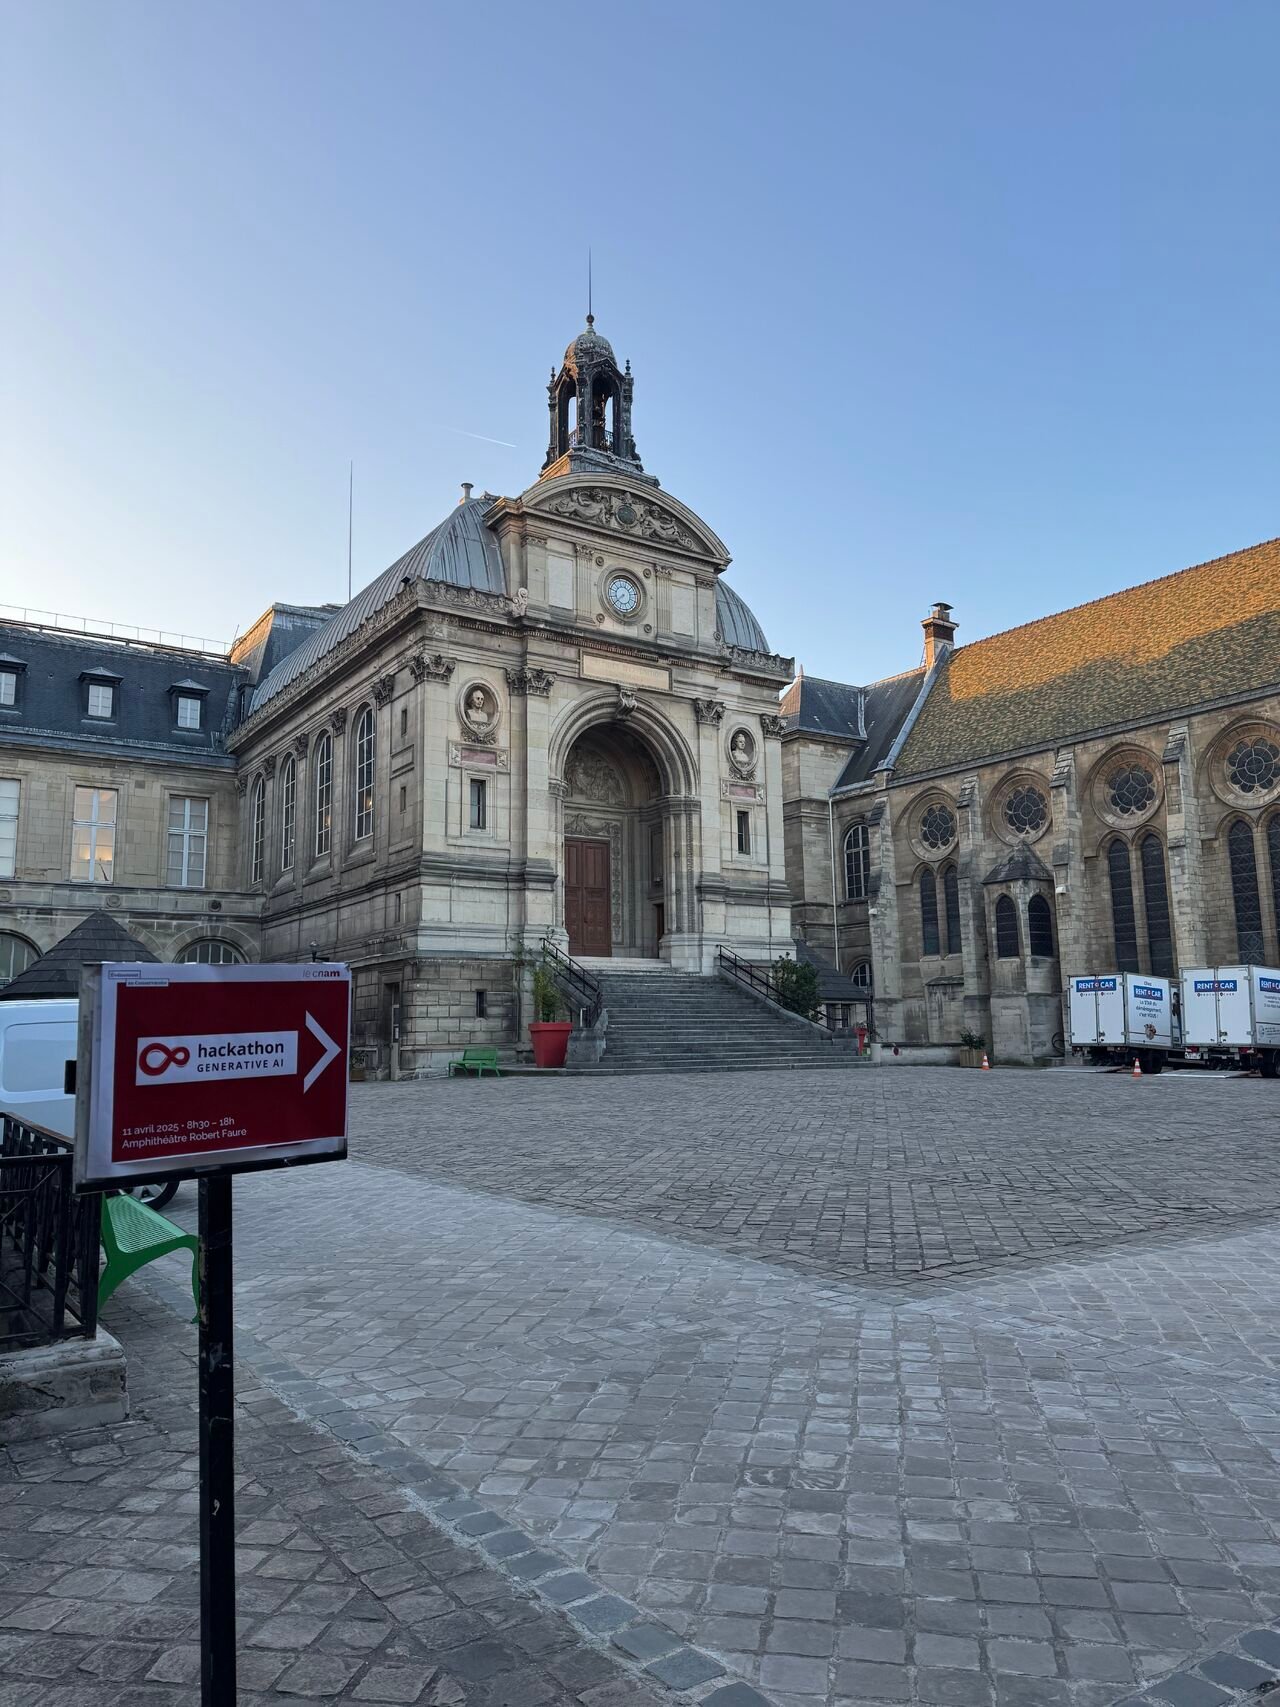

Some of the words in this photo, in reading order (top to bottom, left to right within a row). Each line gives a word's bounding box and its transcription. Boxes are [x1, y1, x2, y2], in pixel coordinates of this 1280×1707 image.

[312, 970, 340, 978] cnam
[1100, 981, 1114, 989] CAR
[1197, 982, 1213, 990] RENT
[1135, 988, 1147, 996] RENT
[1151, 990, 1161, 998] CAR
[198, 1041, 284, 1058] hackathon
[196, 1059, 268, 1073] GENERATIVE
[272, 1059, 284, 1068] AI
[122, 1128, 132, 1136] 11
[134, 1125, 155, 1135] avril
[156, 1123, 179, 1133] 2025
[186, 1120, 210, 1130] 8h30
[219, 1117, 235, 1127] 18h
[122, 1134, 187, 1149] Amphithéâtre
[189, 1130, 220, 1142] Robert
[222, 1128, 247, 1138] Faure
